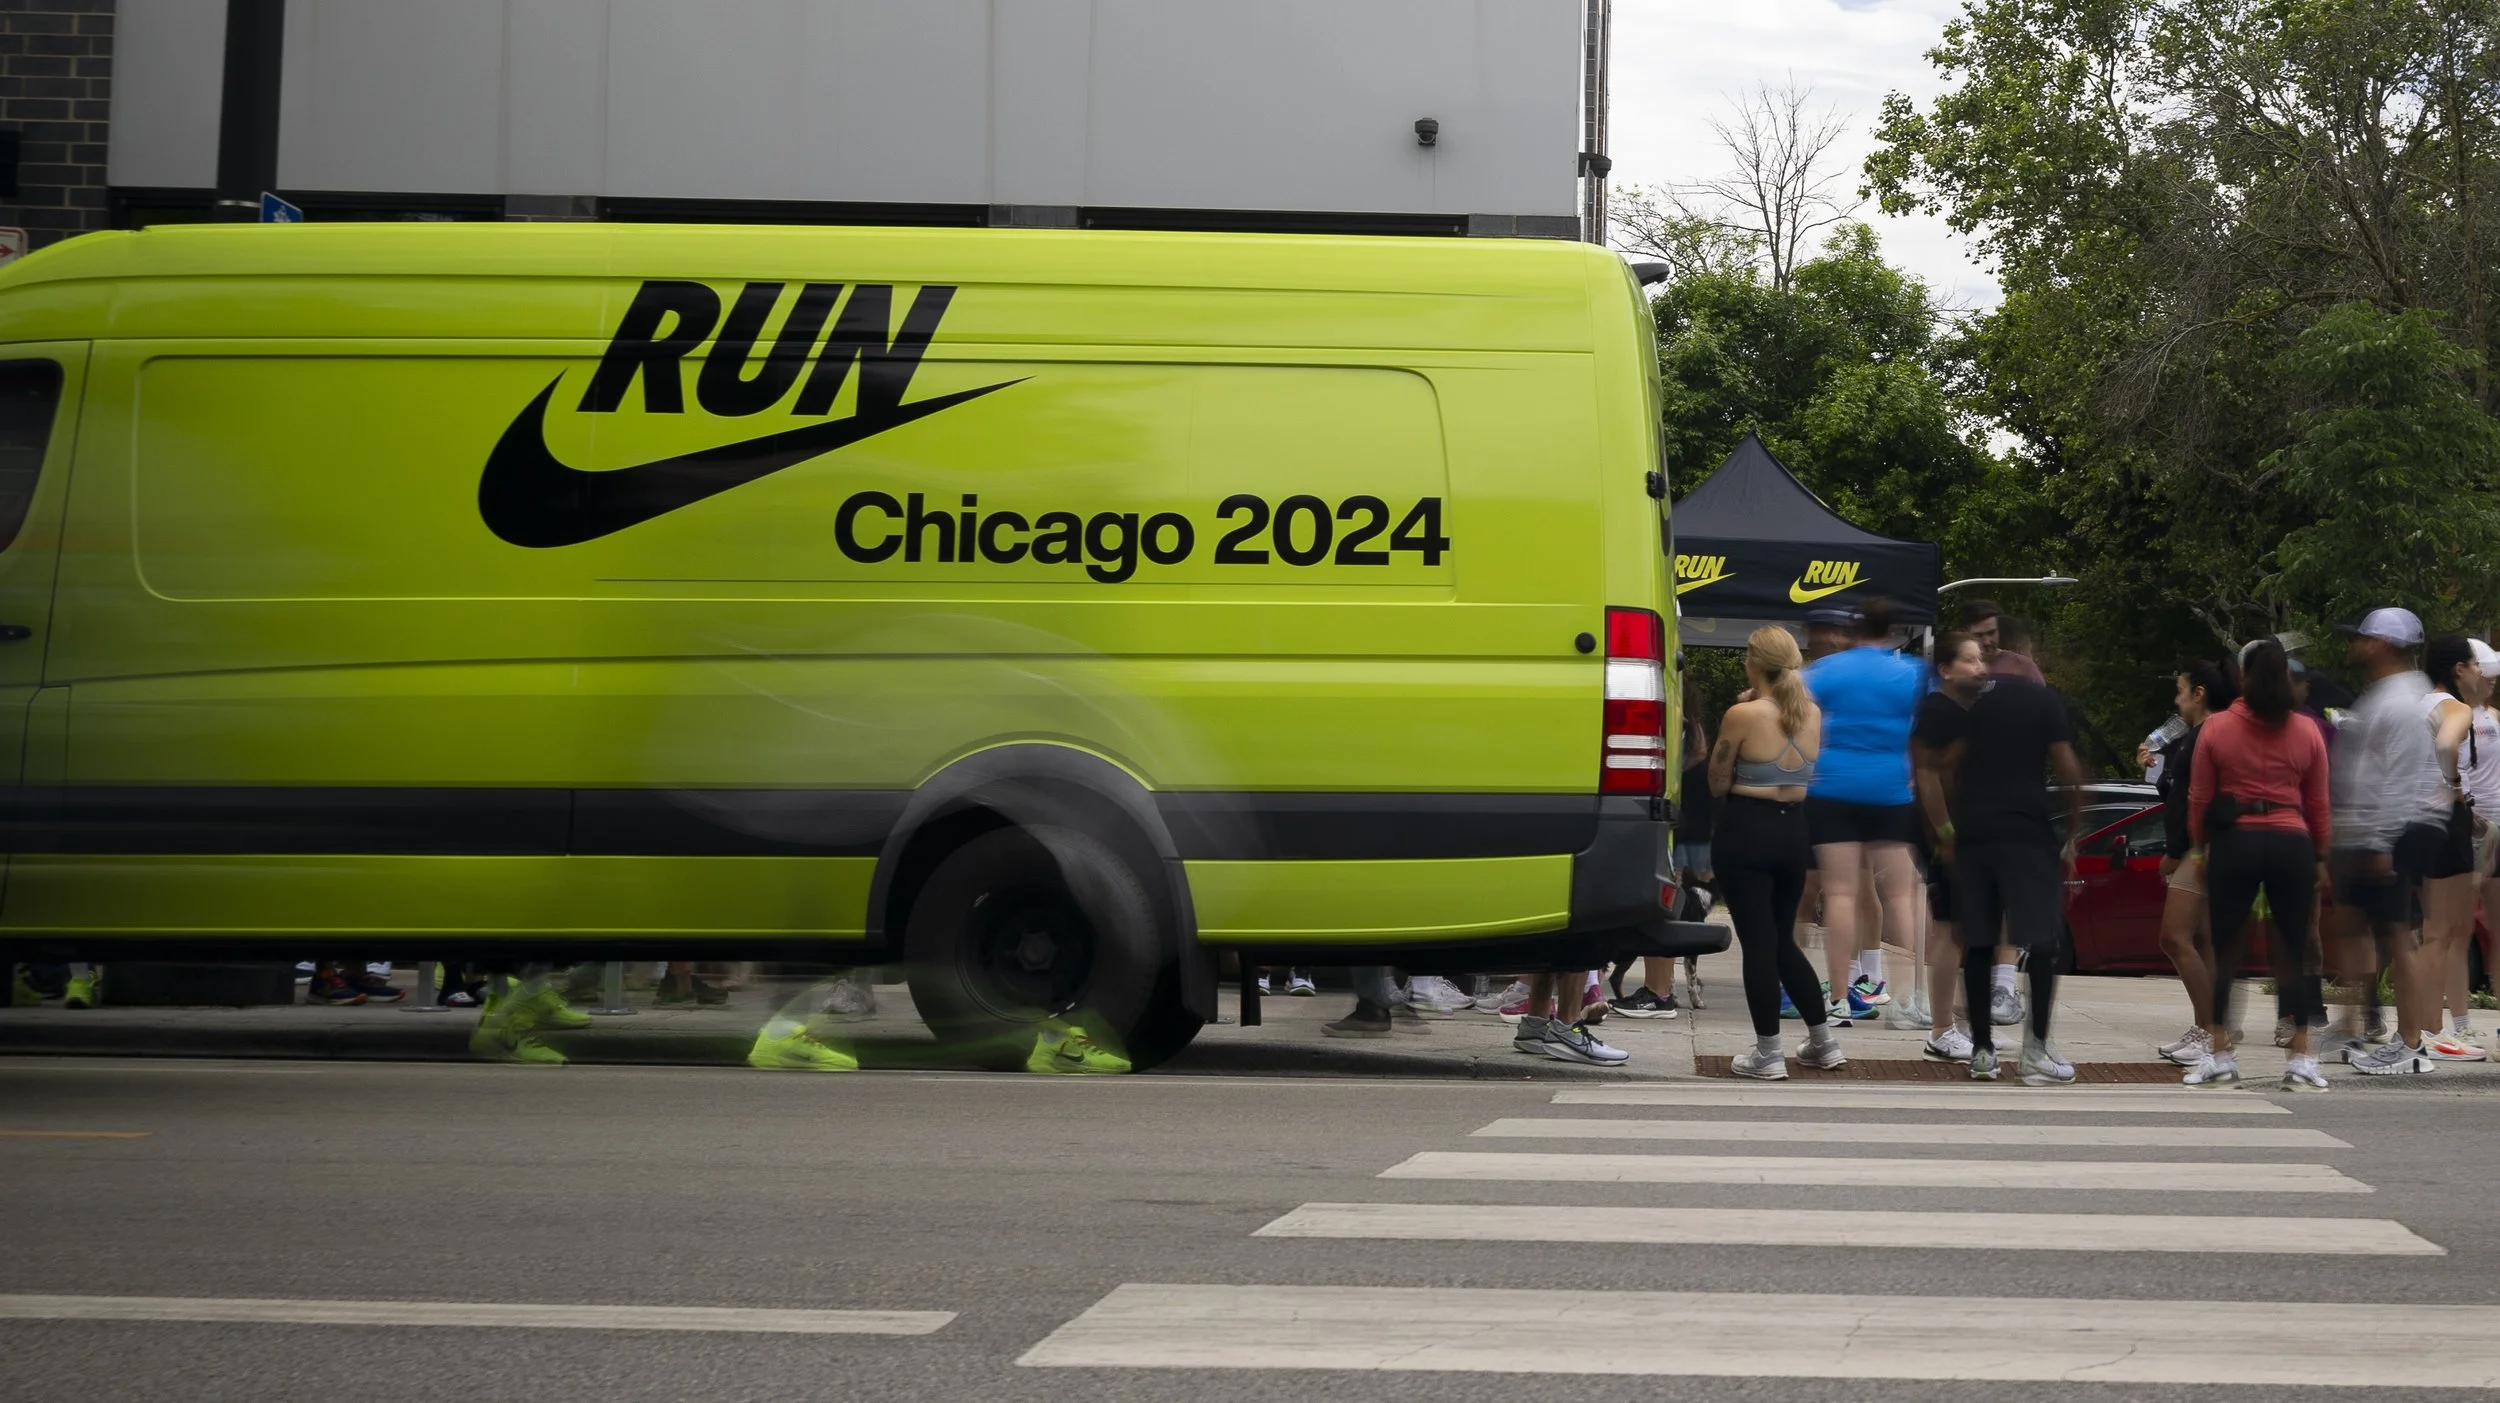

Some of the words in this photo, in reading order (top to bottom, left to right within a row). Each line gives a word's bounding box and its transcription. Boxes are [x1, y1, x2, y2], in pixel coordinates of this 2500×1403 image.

[576, 280, 959, 419] RUN
[834, 490, 1195, 584] Chicago
[1214, 494, 1450, 567] 2024
[1675, 554, 1726, 579] RUN
[1803, 560, 1860, 585] RUN
